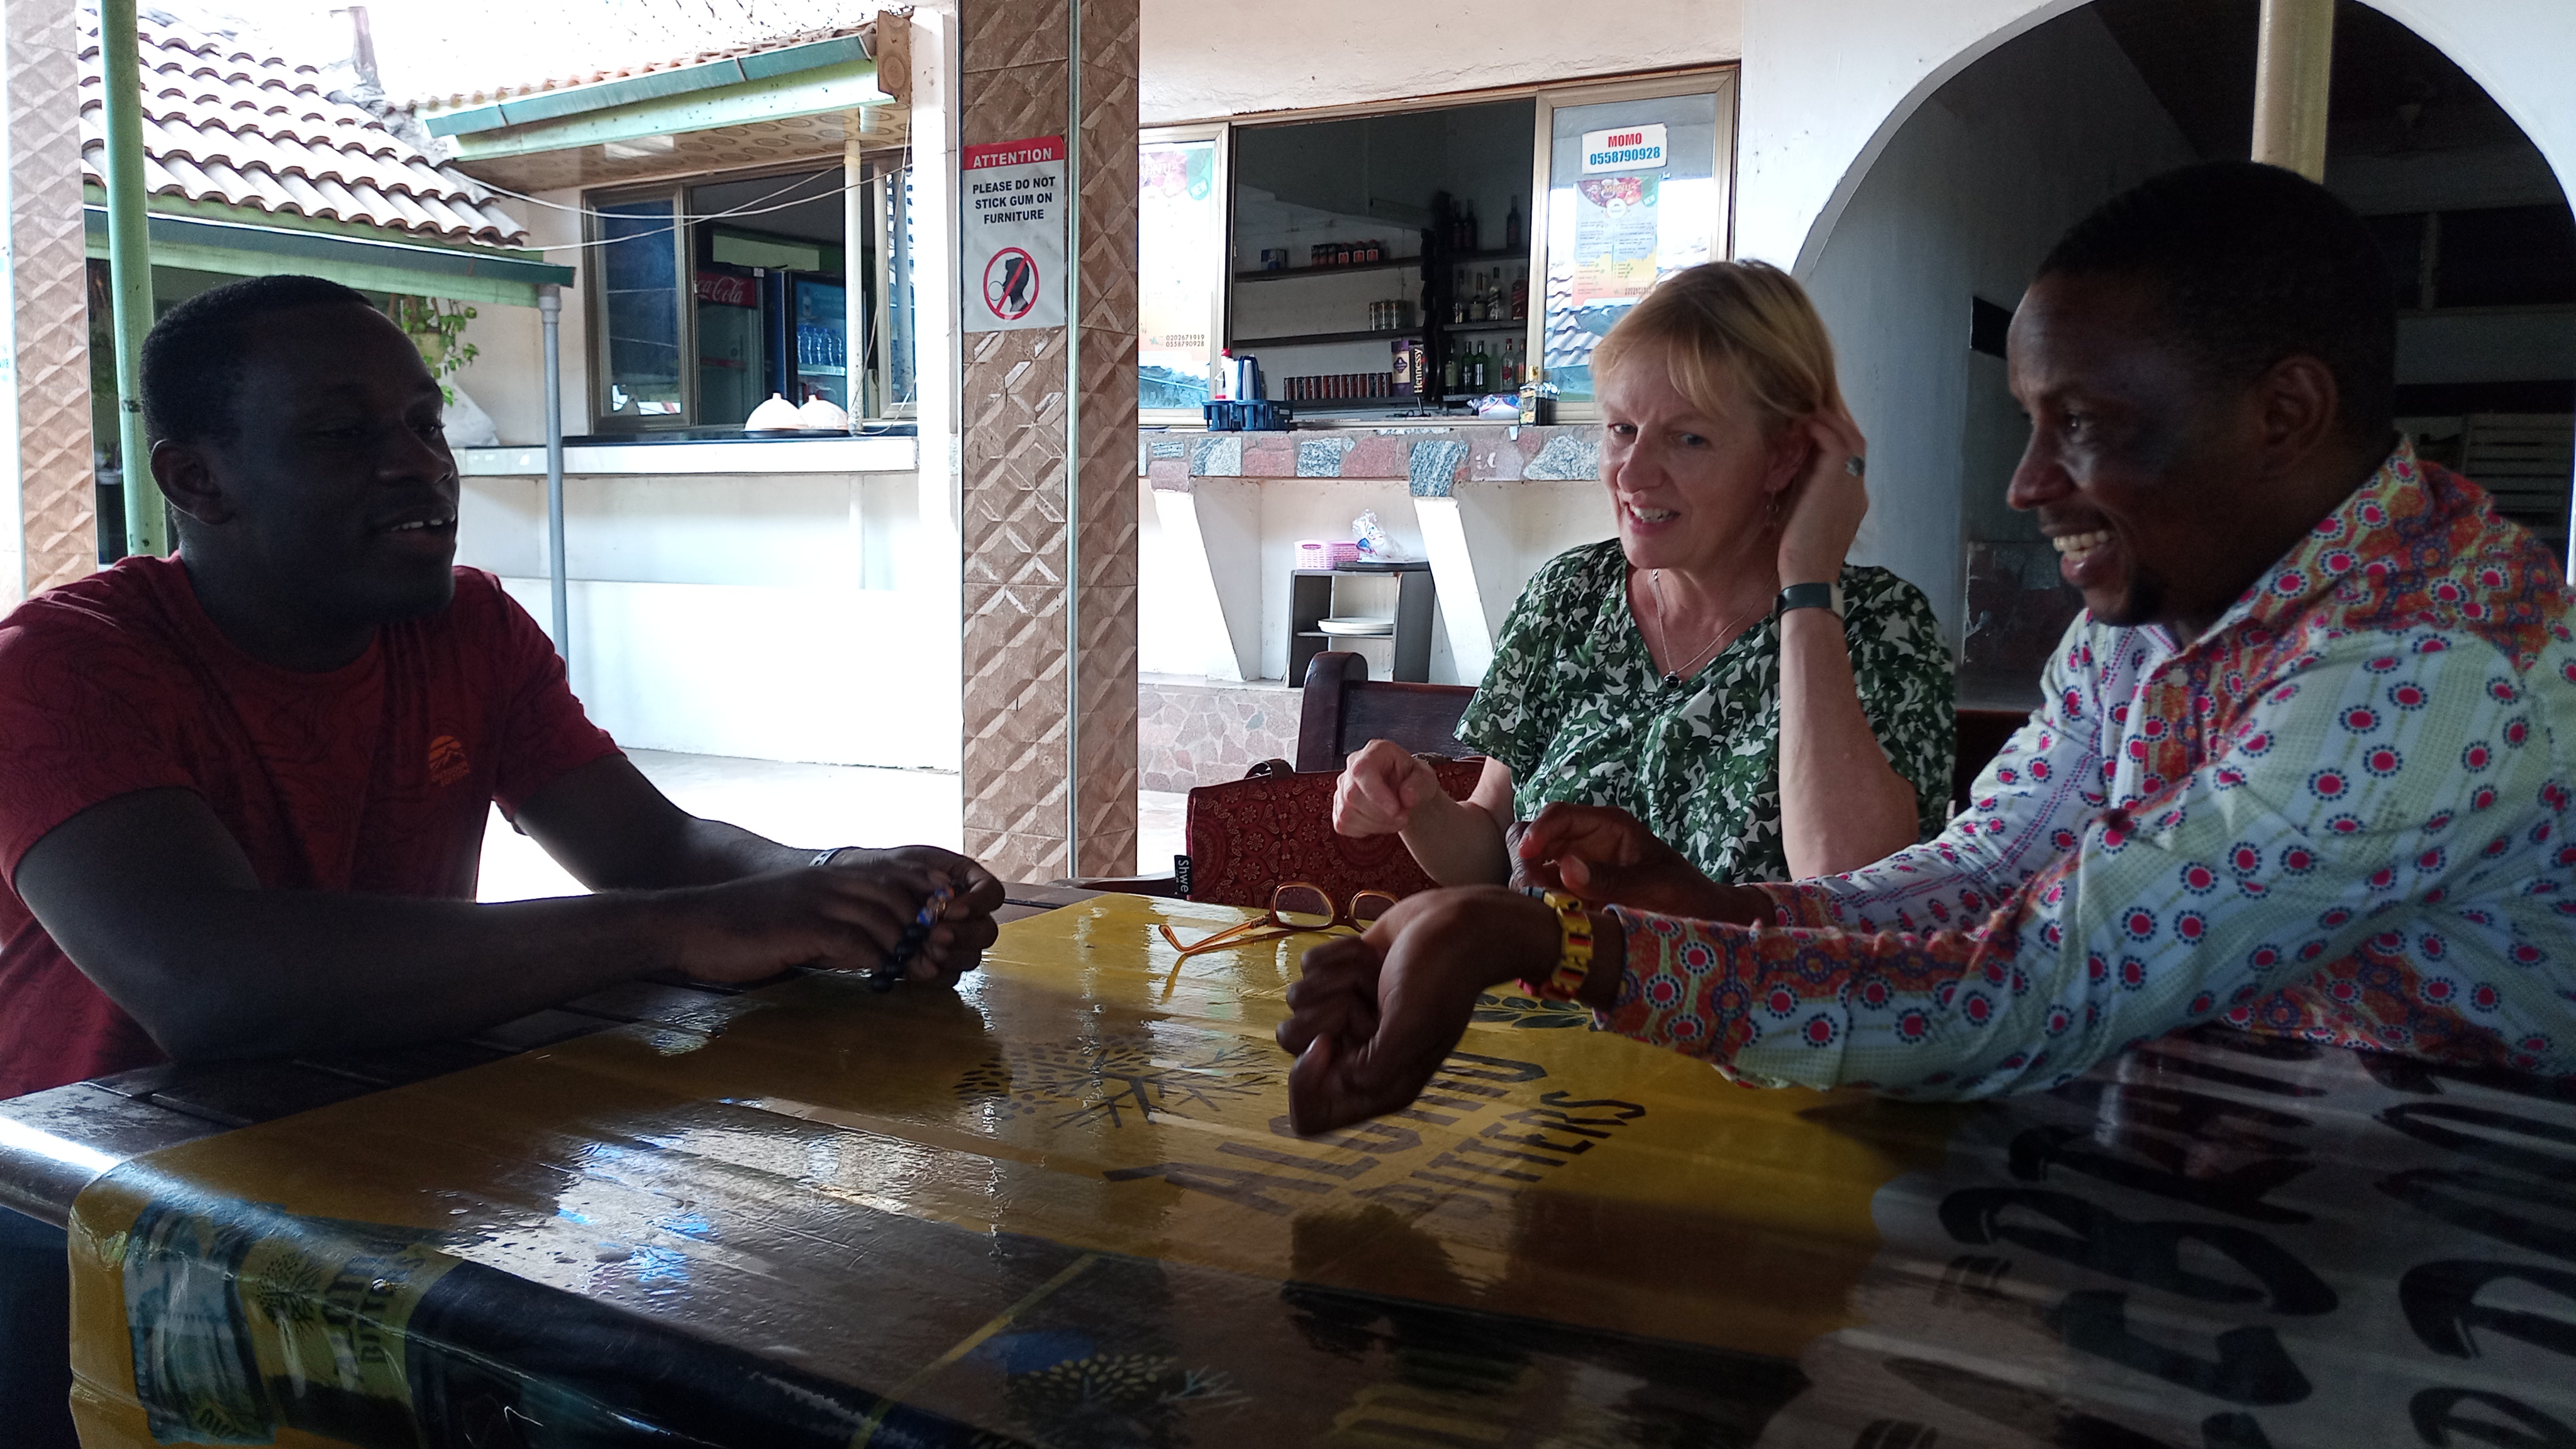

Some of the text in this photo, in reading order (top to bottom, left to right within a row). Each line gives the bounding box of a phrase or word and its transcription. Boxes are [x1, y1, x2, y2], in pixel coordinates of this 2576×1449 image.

[1607, 132, 1643, 148] MOMO
[973, 147, 1052, 168] ATTENTION
[1590, 147, 1661, 166] 0558790928
[972, 176, 1056, 194] PLEASE DO NOT
[975, 192, 1052, 209] STICK GUM ON
[984, 209, 1044, 225] FURNITURE
[1414, 348, 1423, 394] Hennessy
[1178, 859, 1190, 893] Shwe
[1350, 1091, 1646, 1219] BITTERS
